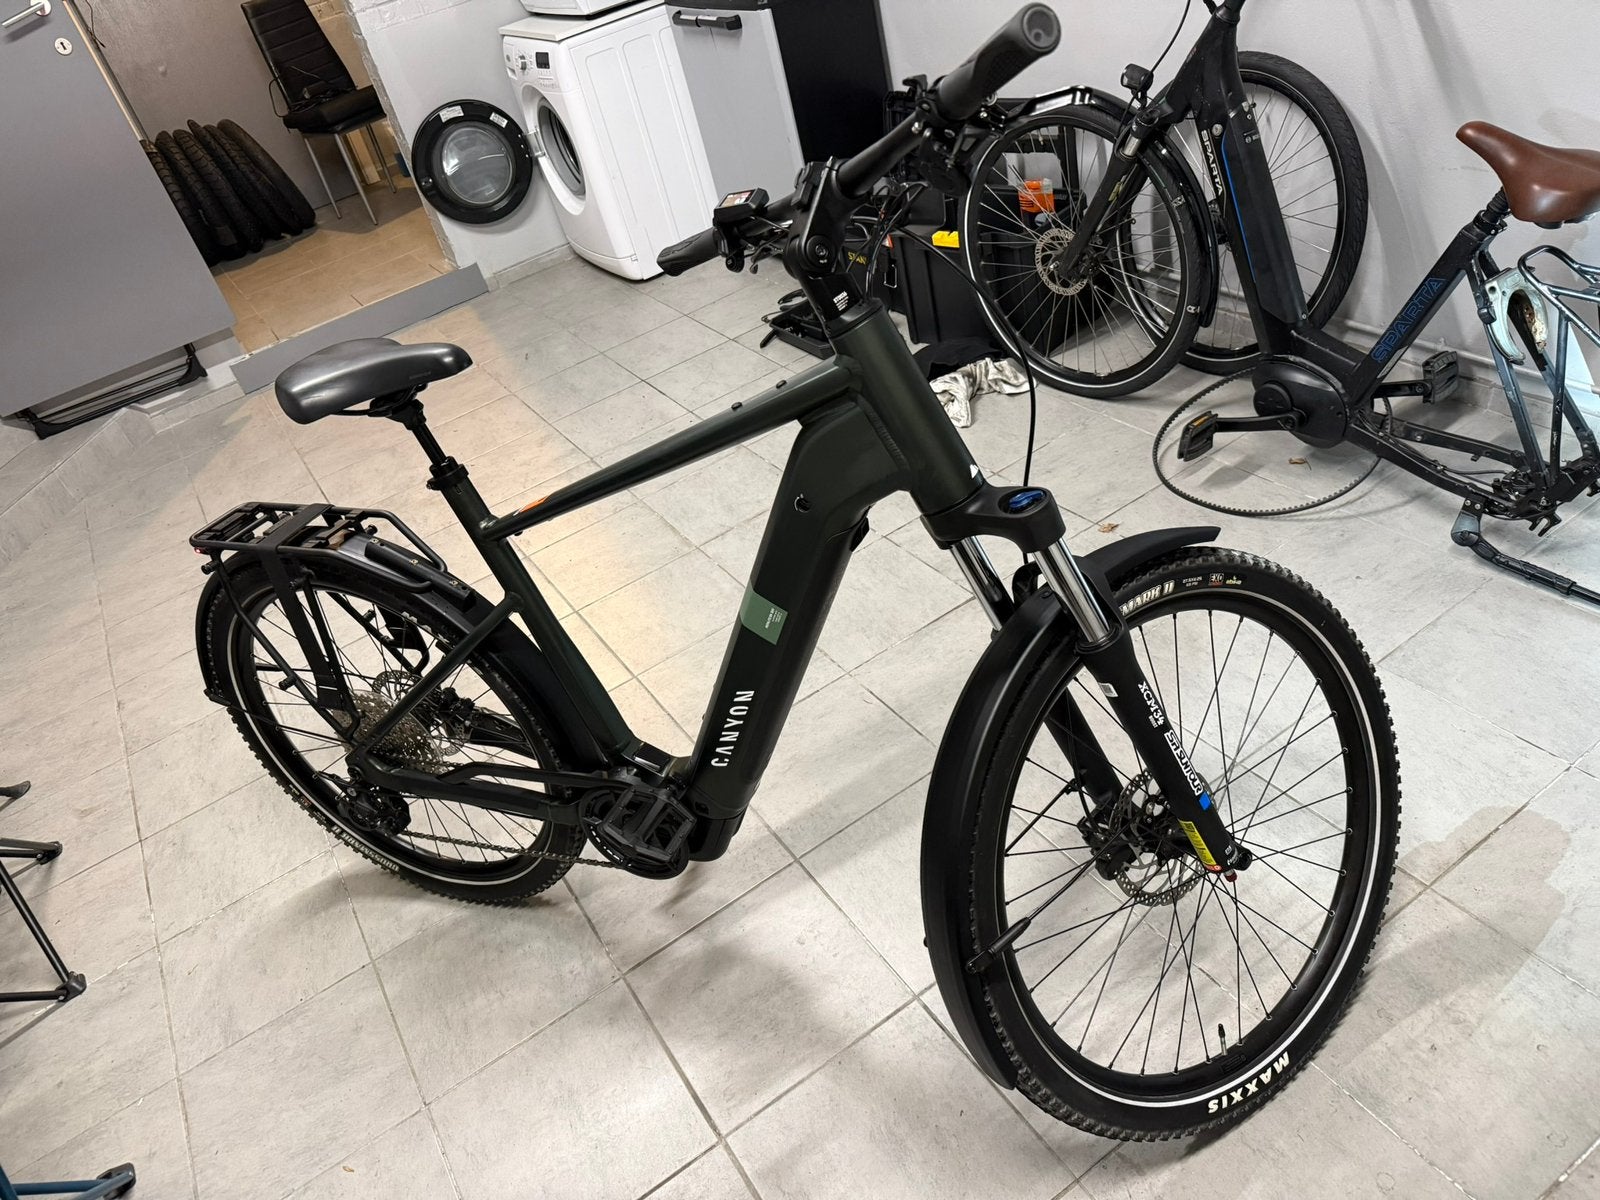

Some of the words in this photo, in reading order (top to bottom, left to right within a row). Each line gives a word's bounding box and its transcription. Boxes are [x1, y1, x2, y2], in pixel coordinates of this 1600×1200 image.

[1201, 129, 1223, 196] SPARTA
[1371, 277, 1446, 363] SPARTA
[711, 690, 755, 767] CANYON
[1138, 681, 1165, 726] XCM34
[1175, 746, 1204, 796] SUNTOUR
[1208, 1051, 1290, 1114] MAXXIS
